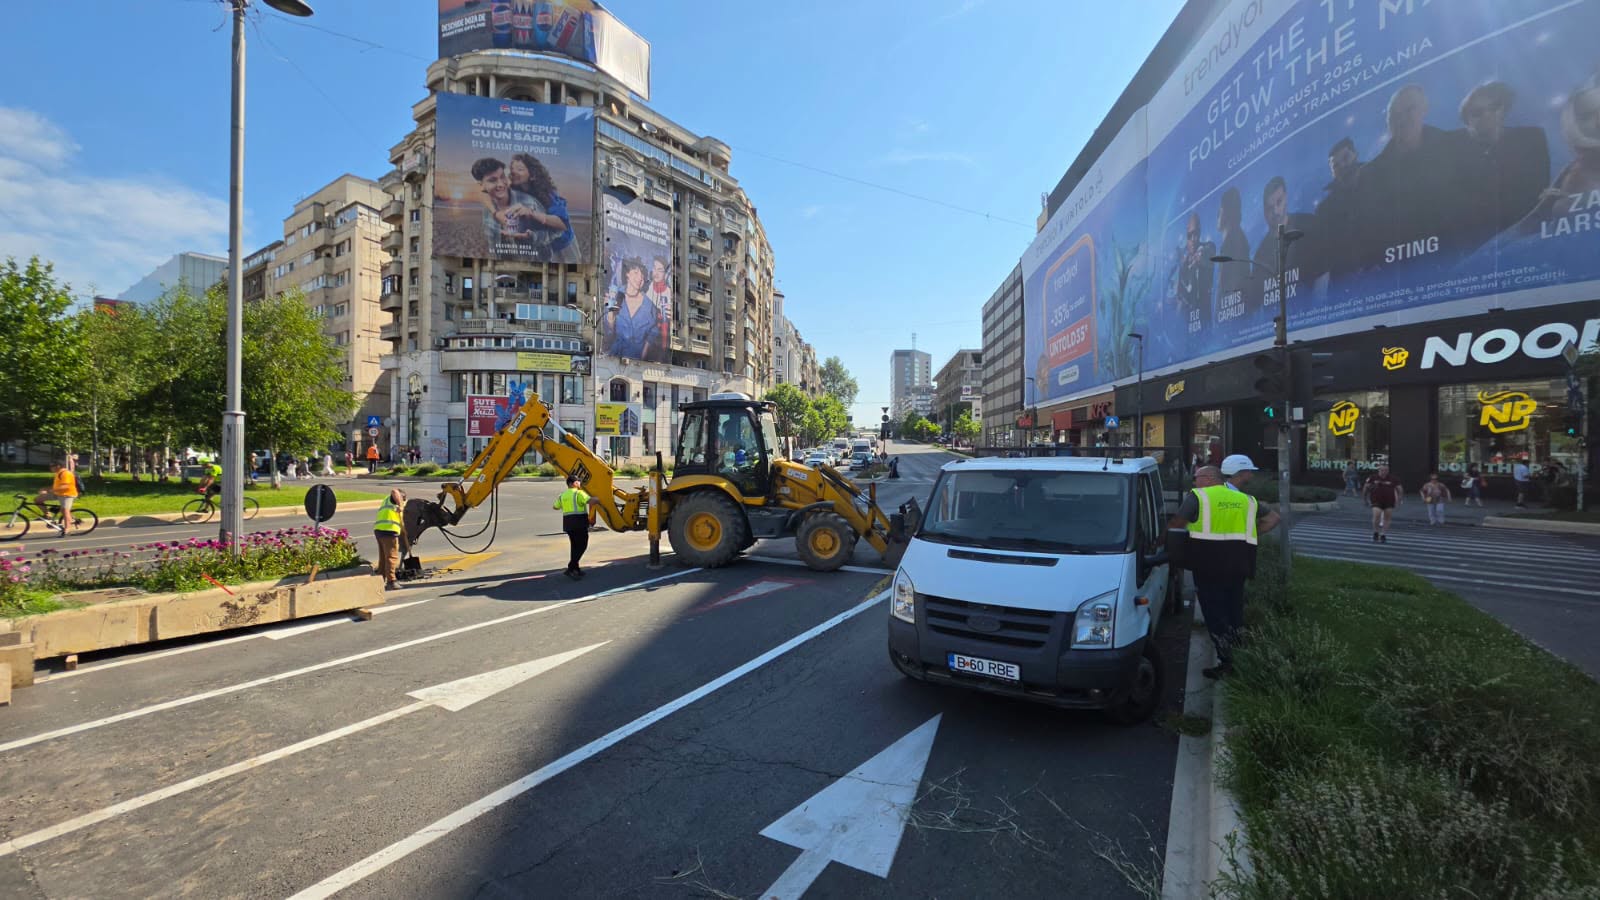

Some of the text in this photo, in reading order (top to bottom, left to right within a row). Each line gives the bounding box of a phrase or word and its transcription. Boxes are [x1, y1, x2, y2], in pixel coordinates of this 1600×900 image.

[1208, 71, 1244, 124] GET
[1252, 17, 1304, 80] THE
[1302, 37, 1433, 114] TRANSYLVANIA
[1188, 77, 1275, 170] FOLLOW
[1285, 18, 1356, 87] THE
[1273, 80, 1319, 119] AUGUST
[1323, 54, 1363, 86] 2026
[472, 129, 491, 137] CU
[493, 131, 512, 140] UN
[504, 122, 512, 130] A
[1384, 236, 1439, 263] STING
[1221, 291, 1242, 309] LEWIS
[1263, 284, 1297, 306] GARIX
[1218, 303, 1245, 322] CAPALDI
[473, 398, 496, 406] SUTE
[1479, 398, 1537, 426] NP
[1311, 460, 1380, 470] JOIN TH PAC
[957, 656, 1016, 678] B 60 RBE
